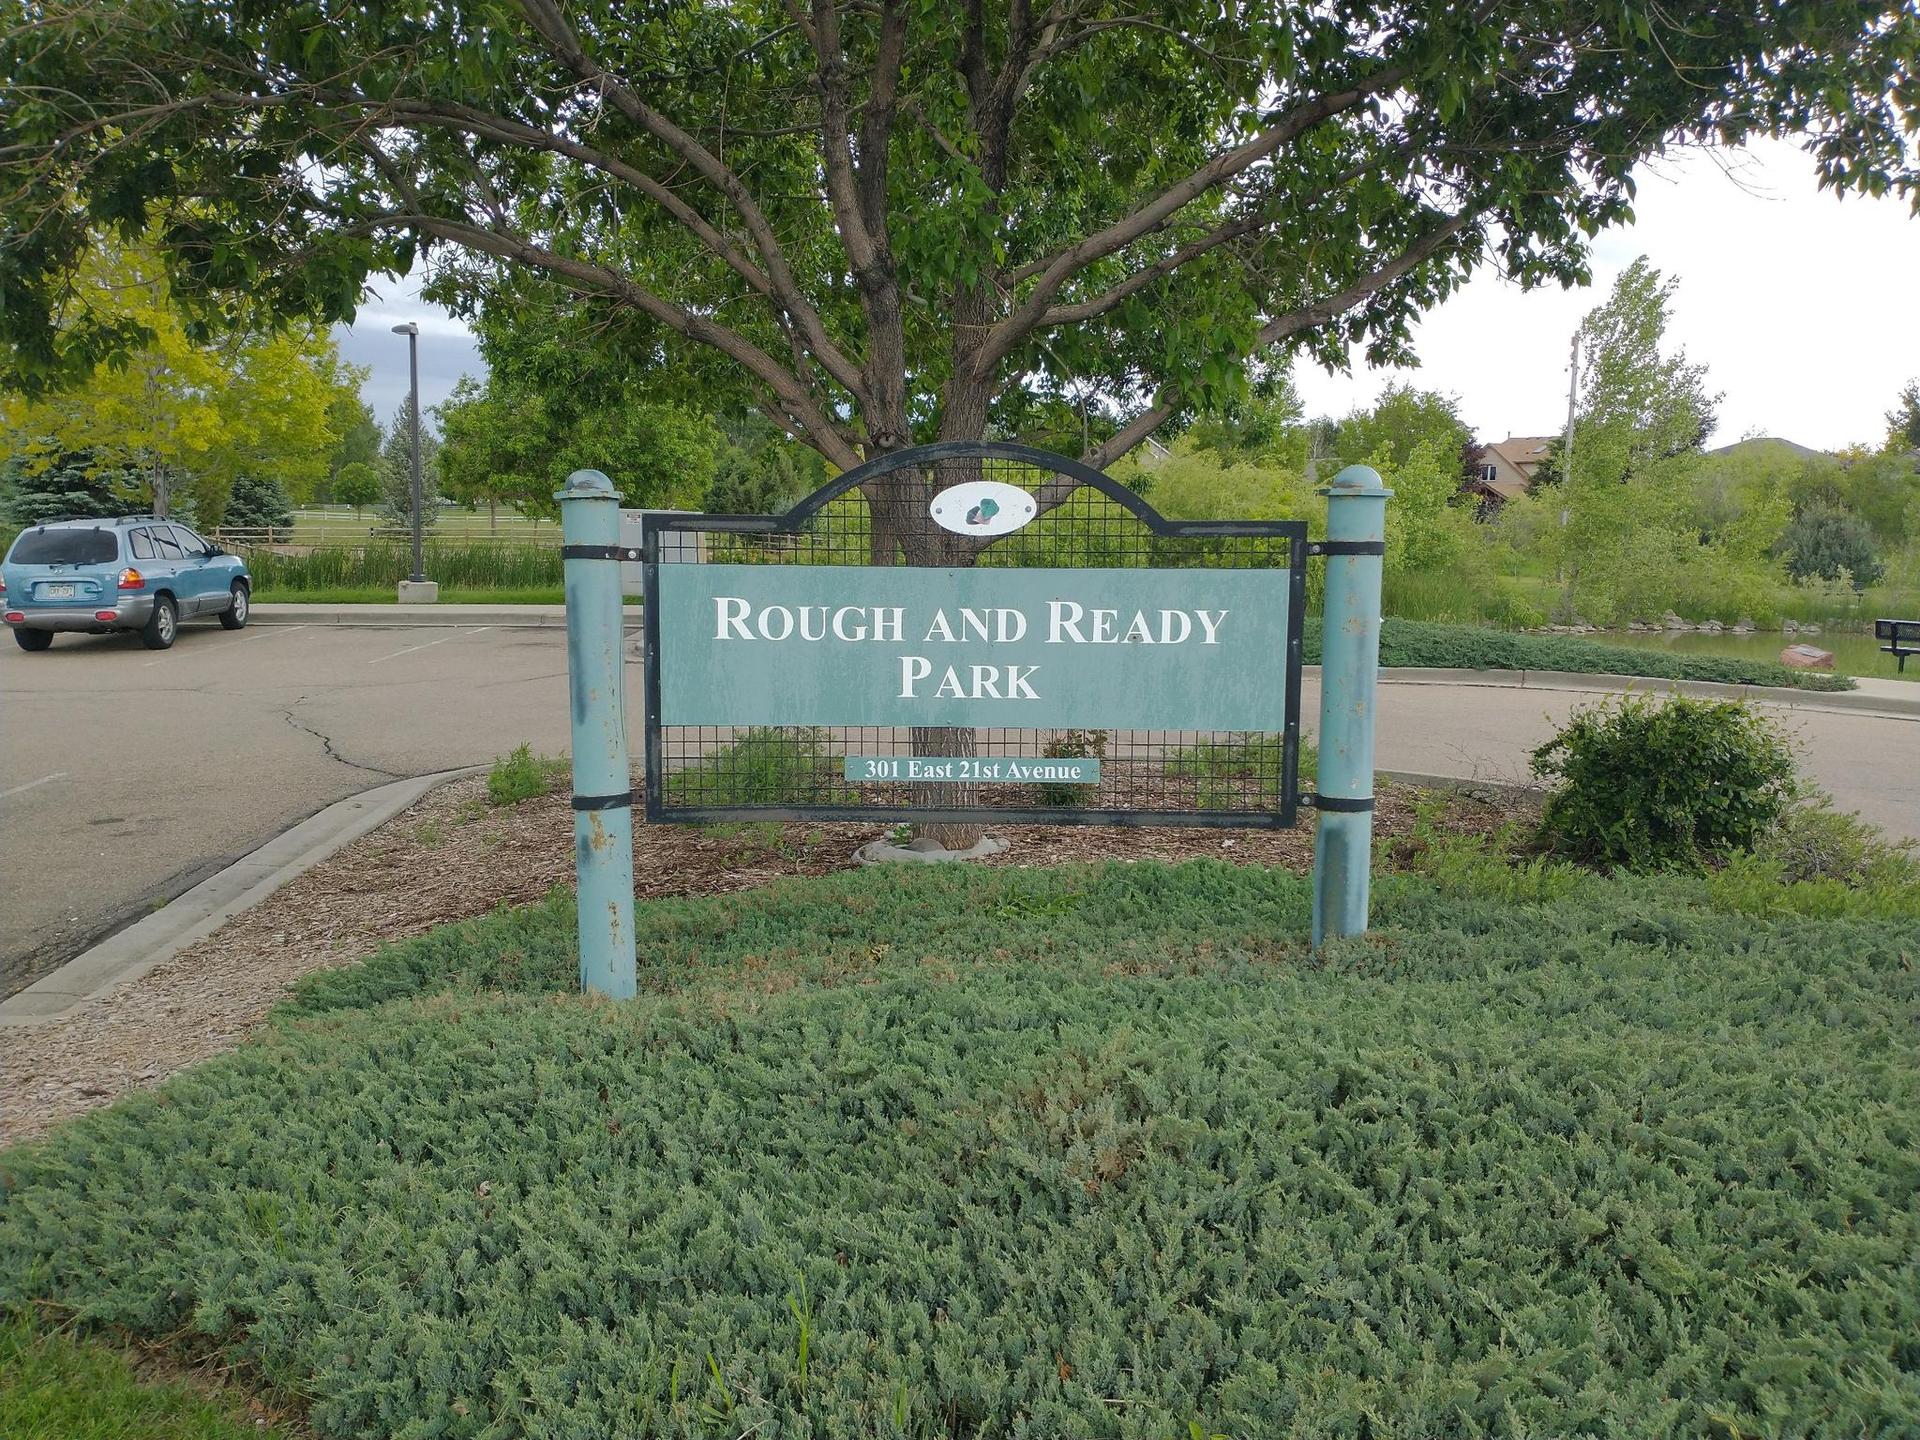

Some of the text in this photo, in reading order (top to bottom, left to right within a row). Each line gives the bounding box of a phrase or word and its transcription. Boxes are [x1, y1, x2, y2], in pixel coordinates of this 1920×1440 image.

[711, 597, 1230, 645] ROUGH AND READY
[896, 656, 1042, 701] PARK
[864, 760, 1082, 781] 301 East 21st Avenue
